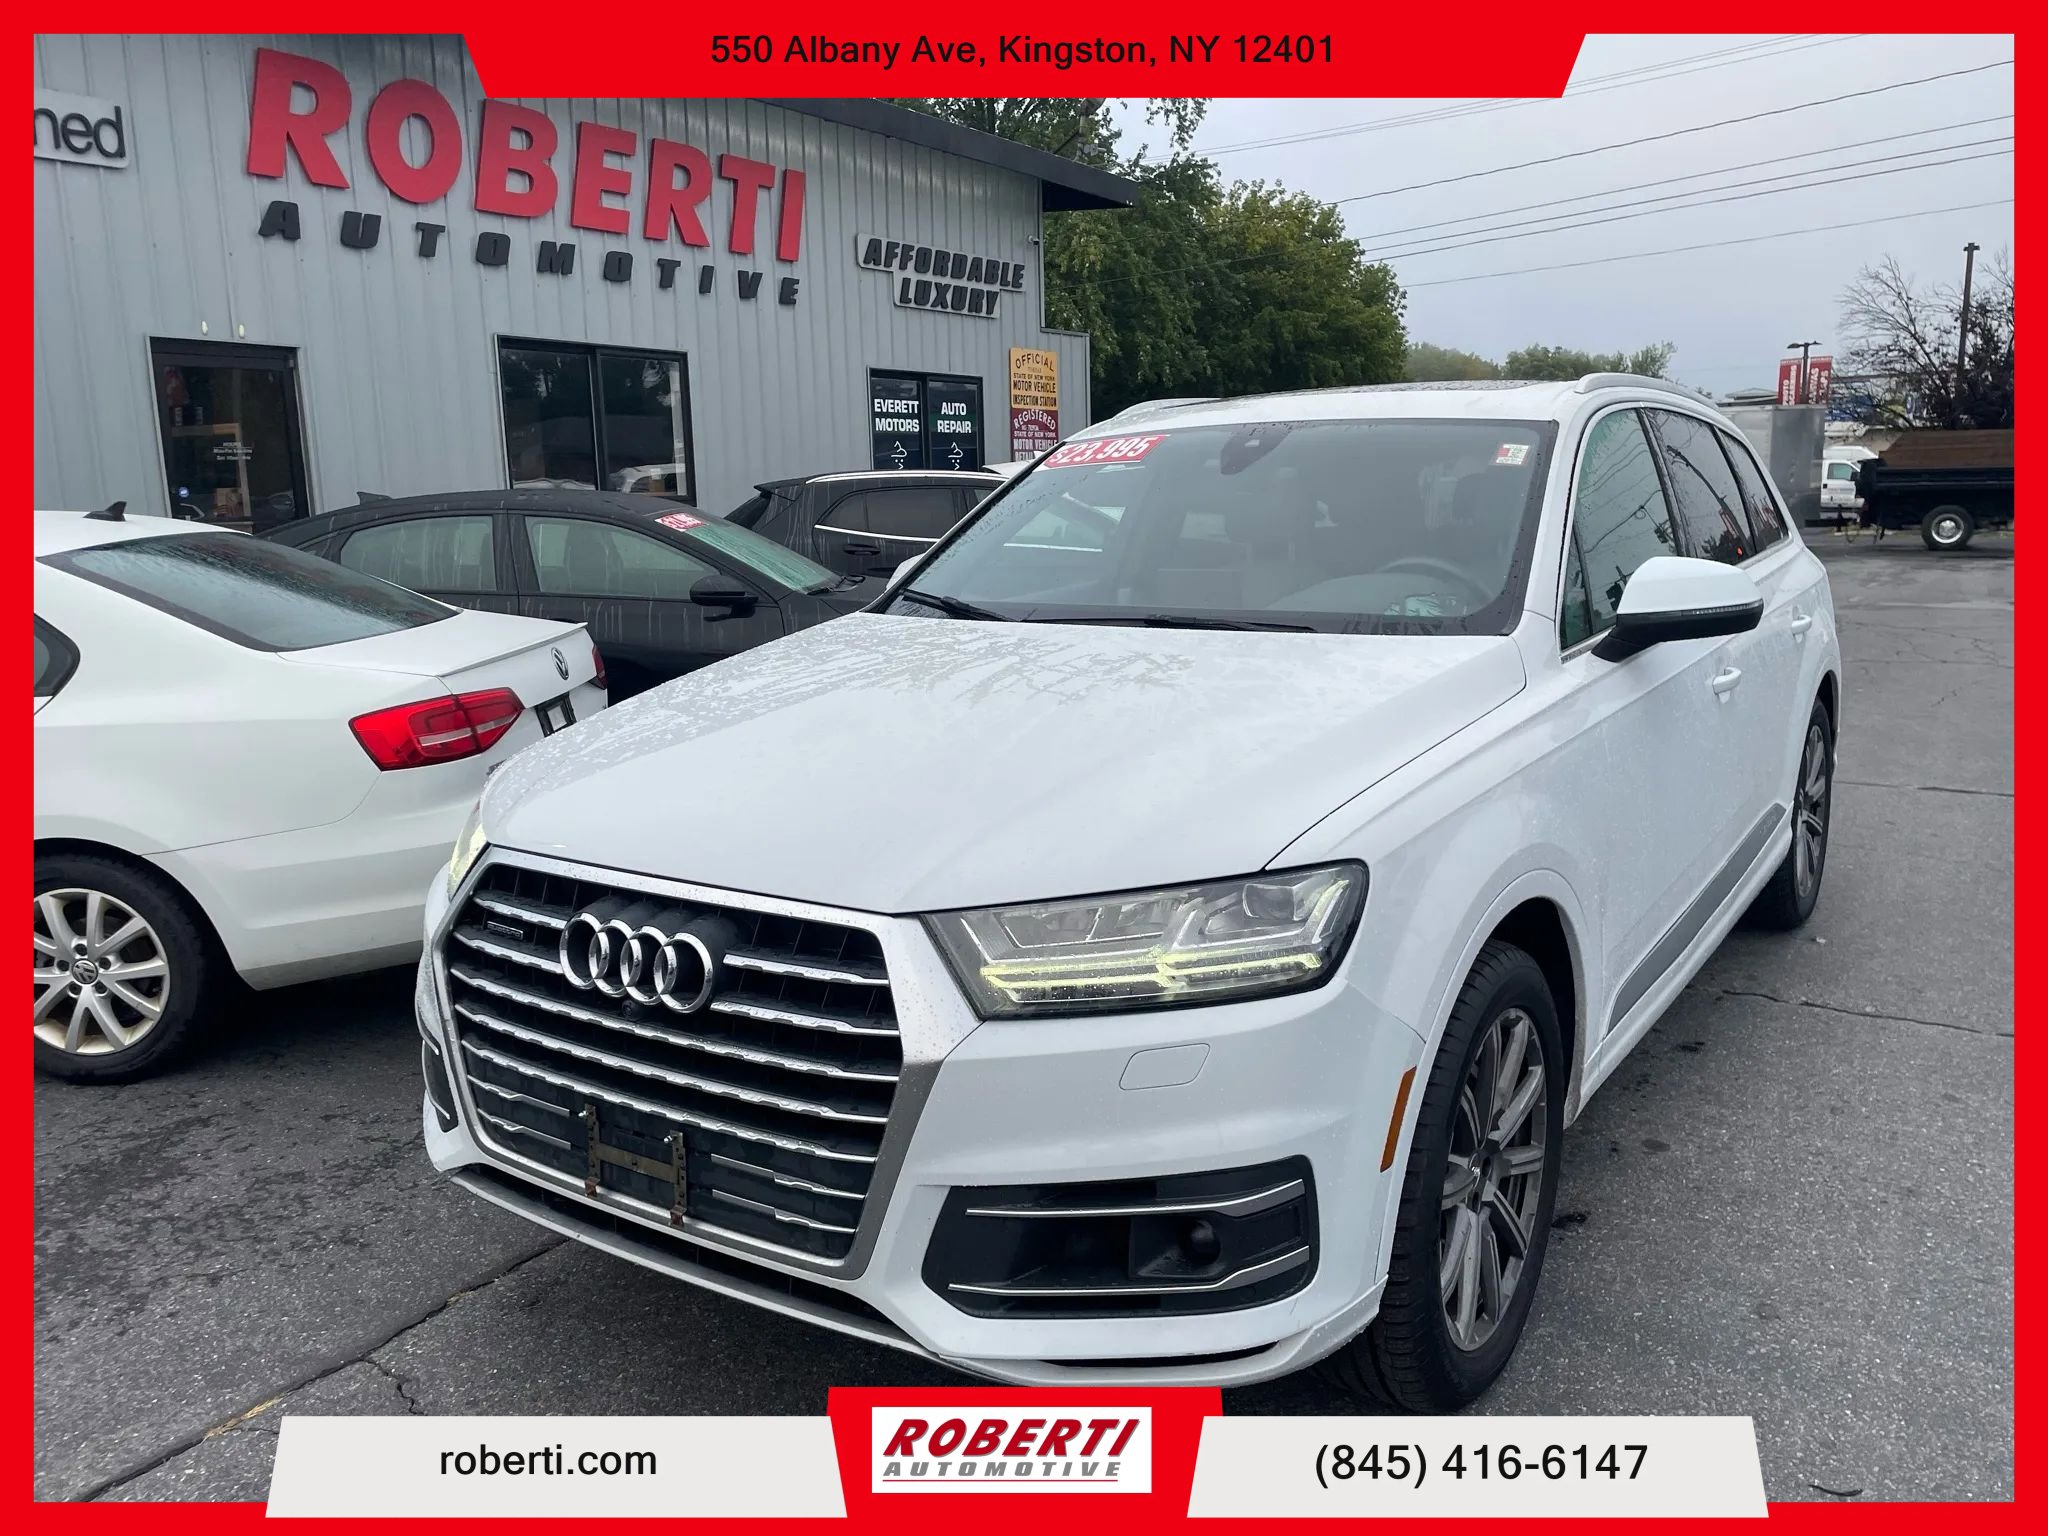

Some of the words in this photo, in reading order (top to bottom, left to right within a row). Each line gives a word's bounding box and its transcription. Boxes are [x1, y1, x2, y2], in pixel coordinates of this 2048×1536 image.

[247, 47, 806, 262] ROBERTI
[258, 200, 800, 305] AUTOMOTIVE
[863, 238, 1025, 289] AFFORDABLE
[899, 277, 1000, 315] LUXURY
[1015, 352, 1054, 372] OFFICIAL
[1013, 372, 1026, 380] STATE
[1034, 373, 1046, 381] NEW
[1045, 374, 1055, 382] YORK
[1013, 379, 1032, 391] MOTOR
[1034, 381, 1056, 394] VEHICLE
[874, 398, 919, 414] EVERETT
[941, 402, 967, 415] AUTO
[1013, 394, 1039, 407] INSPECTION
[1039, 395, 1057, 407] STATION
[875, 417, 920, 432] MOTORS
[937, 419, 972, 433] REPAIR
[1014, 409, 1056, 430] REGISTERED
[1013, 438, 1033, 450] MOTOR
[1051, 436, 1158, 463] $23,995
